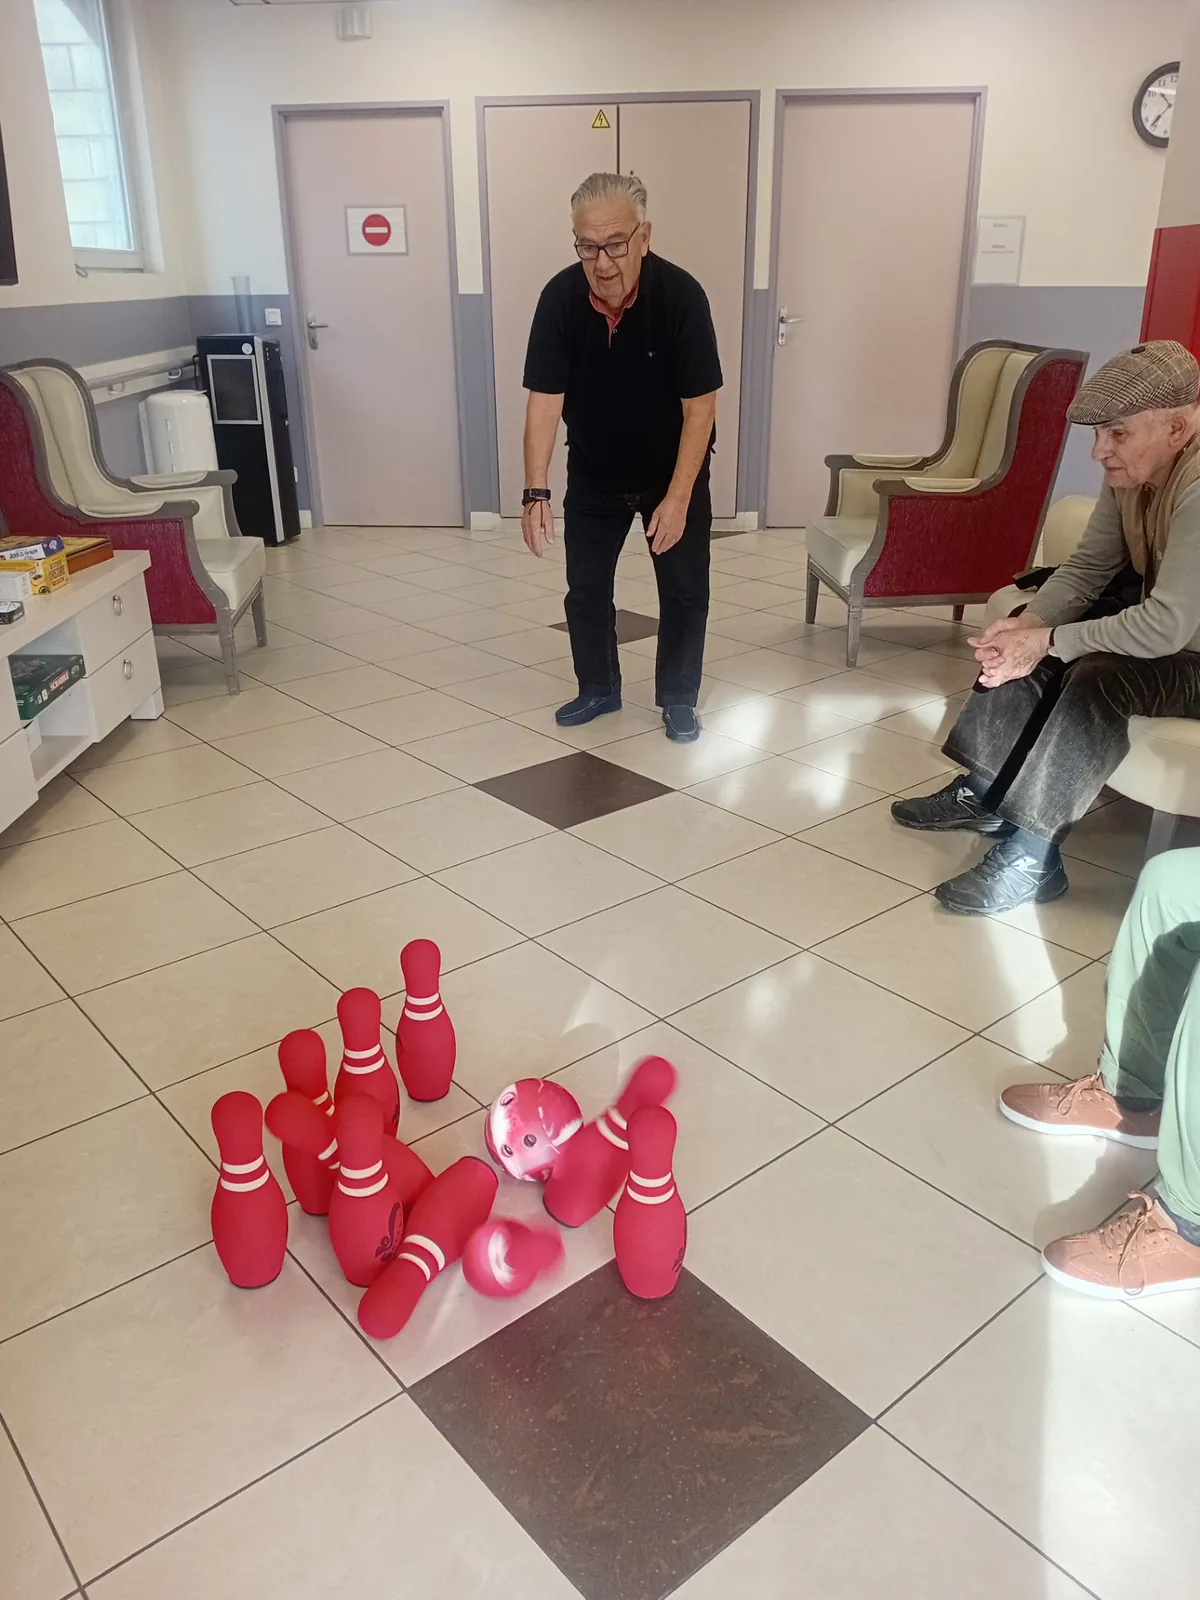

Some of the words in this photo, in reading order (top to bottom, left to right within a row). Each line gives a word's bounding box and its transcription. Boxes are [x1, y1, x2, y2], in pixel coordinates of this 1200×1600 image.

[1158, 79, 1166, 87] 11
[1170, 75, 1179, 83] 12
[1147, 90, 1156, 98] 10
